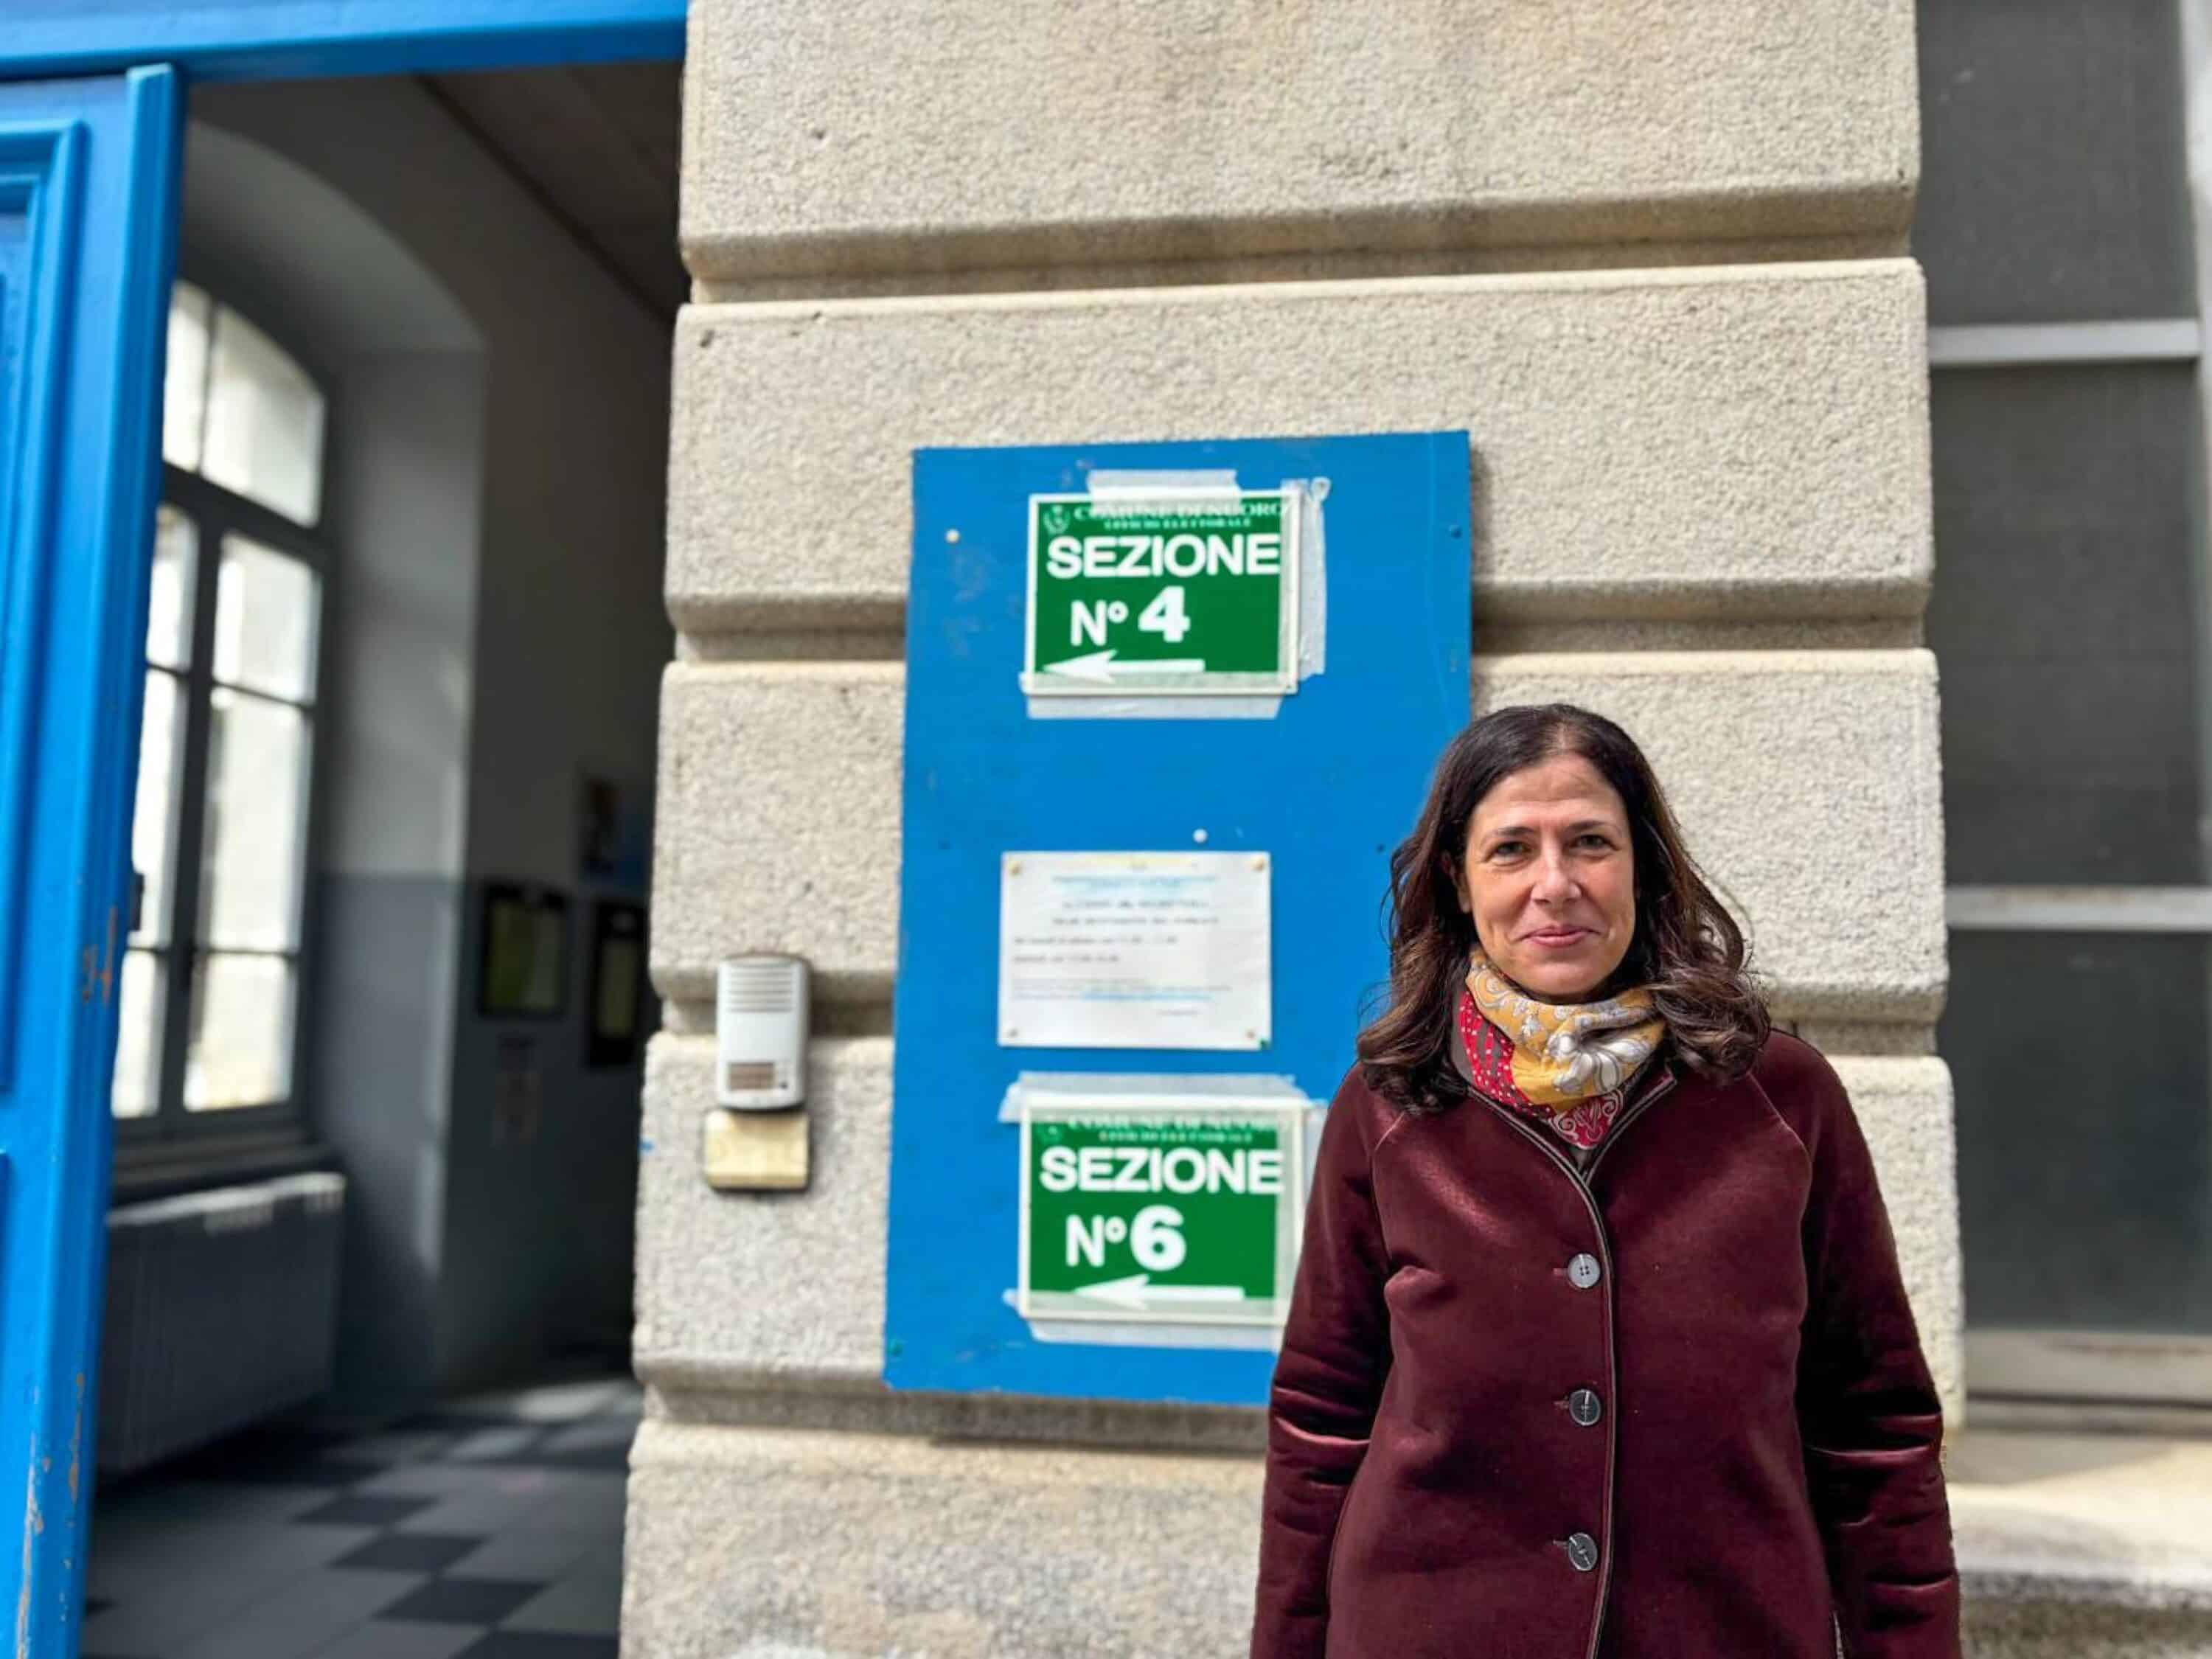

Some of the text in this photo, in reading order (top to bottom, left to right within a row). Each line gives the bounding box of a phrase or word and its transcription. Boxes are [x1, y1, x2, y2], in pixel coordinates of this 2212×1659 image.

[1046, 534, 1281, 579] SEZIONE
[1138, 585, 1191, 642] 4
[1040, 1147, 1284, 1194] SEZIONE
[1130, 1204, 1186, 1271] 6
